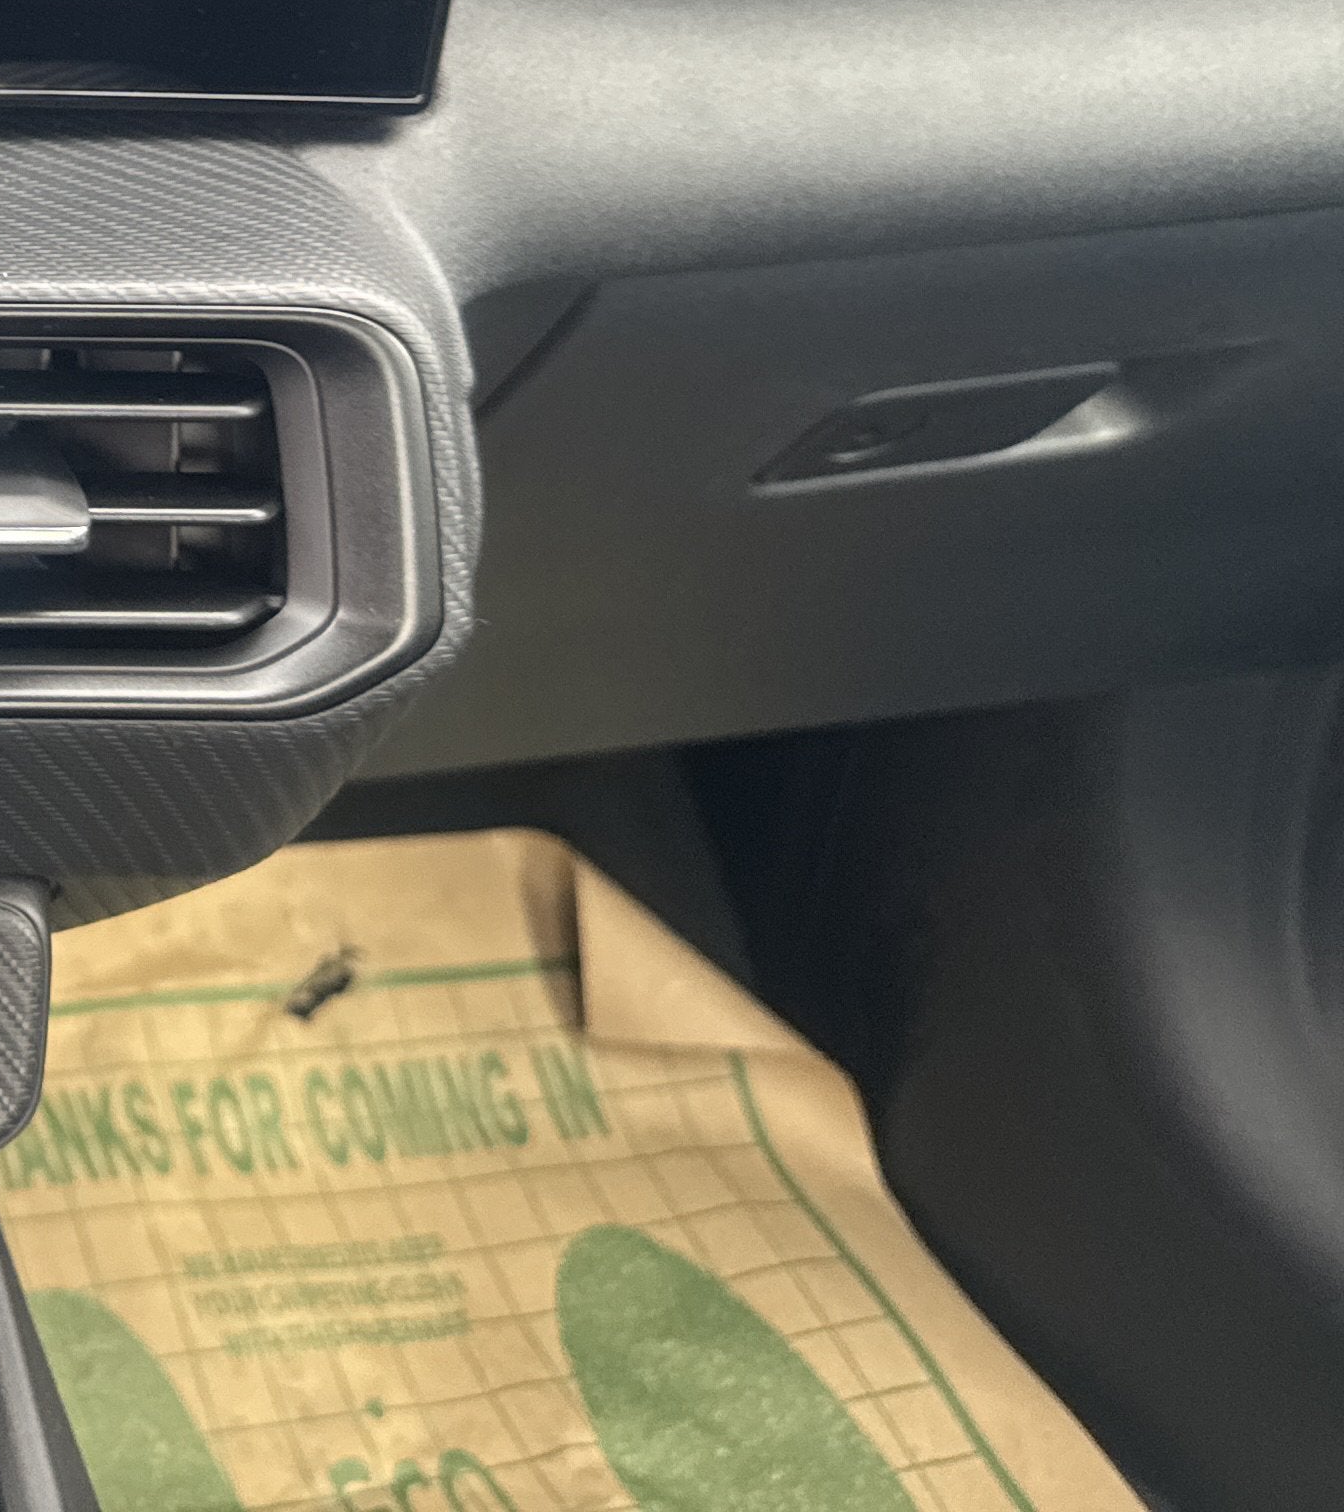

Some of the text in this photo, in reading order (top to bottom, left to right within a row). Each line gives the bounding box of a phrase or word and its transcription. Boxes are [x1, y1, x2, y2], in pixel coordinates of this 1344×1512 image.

[168, 1072, 300, 1178] FOR
[303, 1048, 533, 1166] COMING
[529, 1042, 611, 1143] IN
